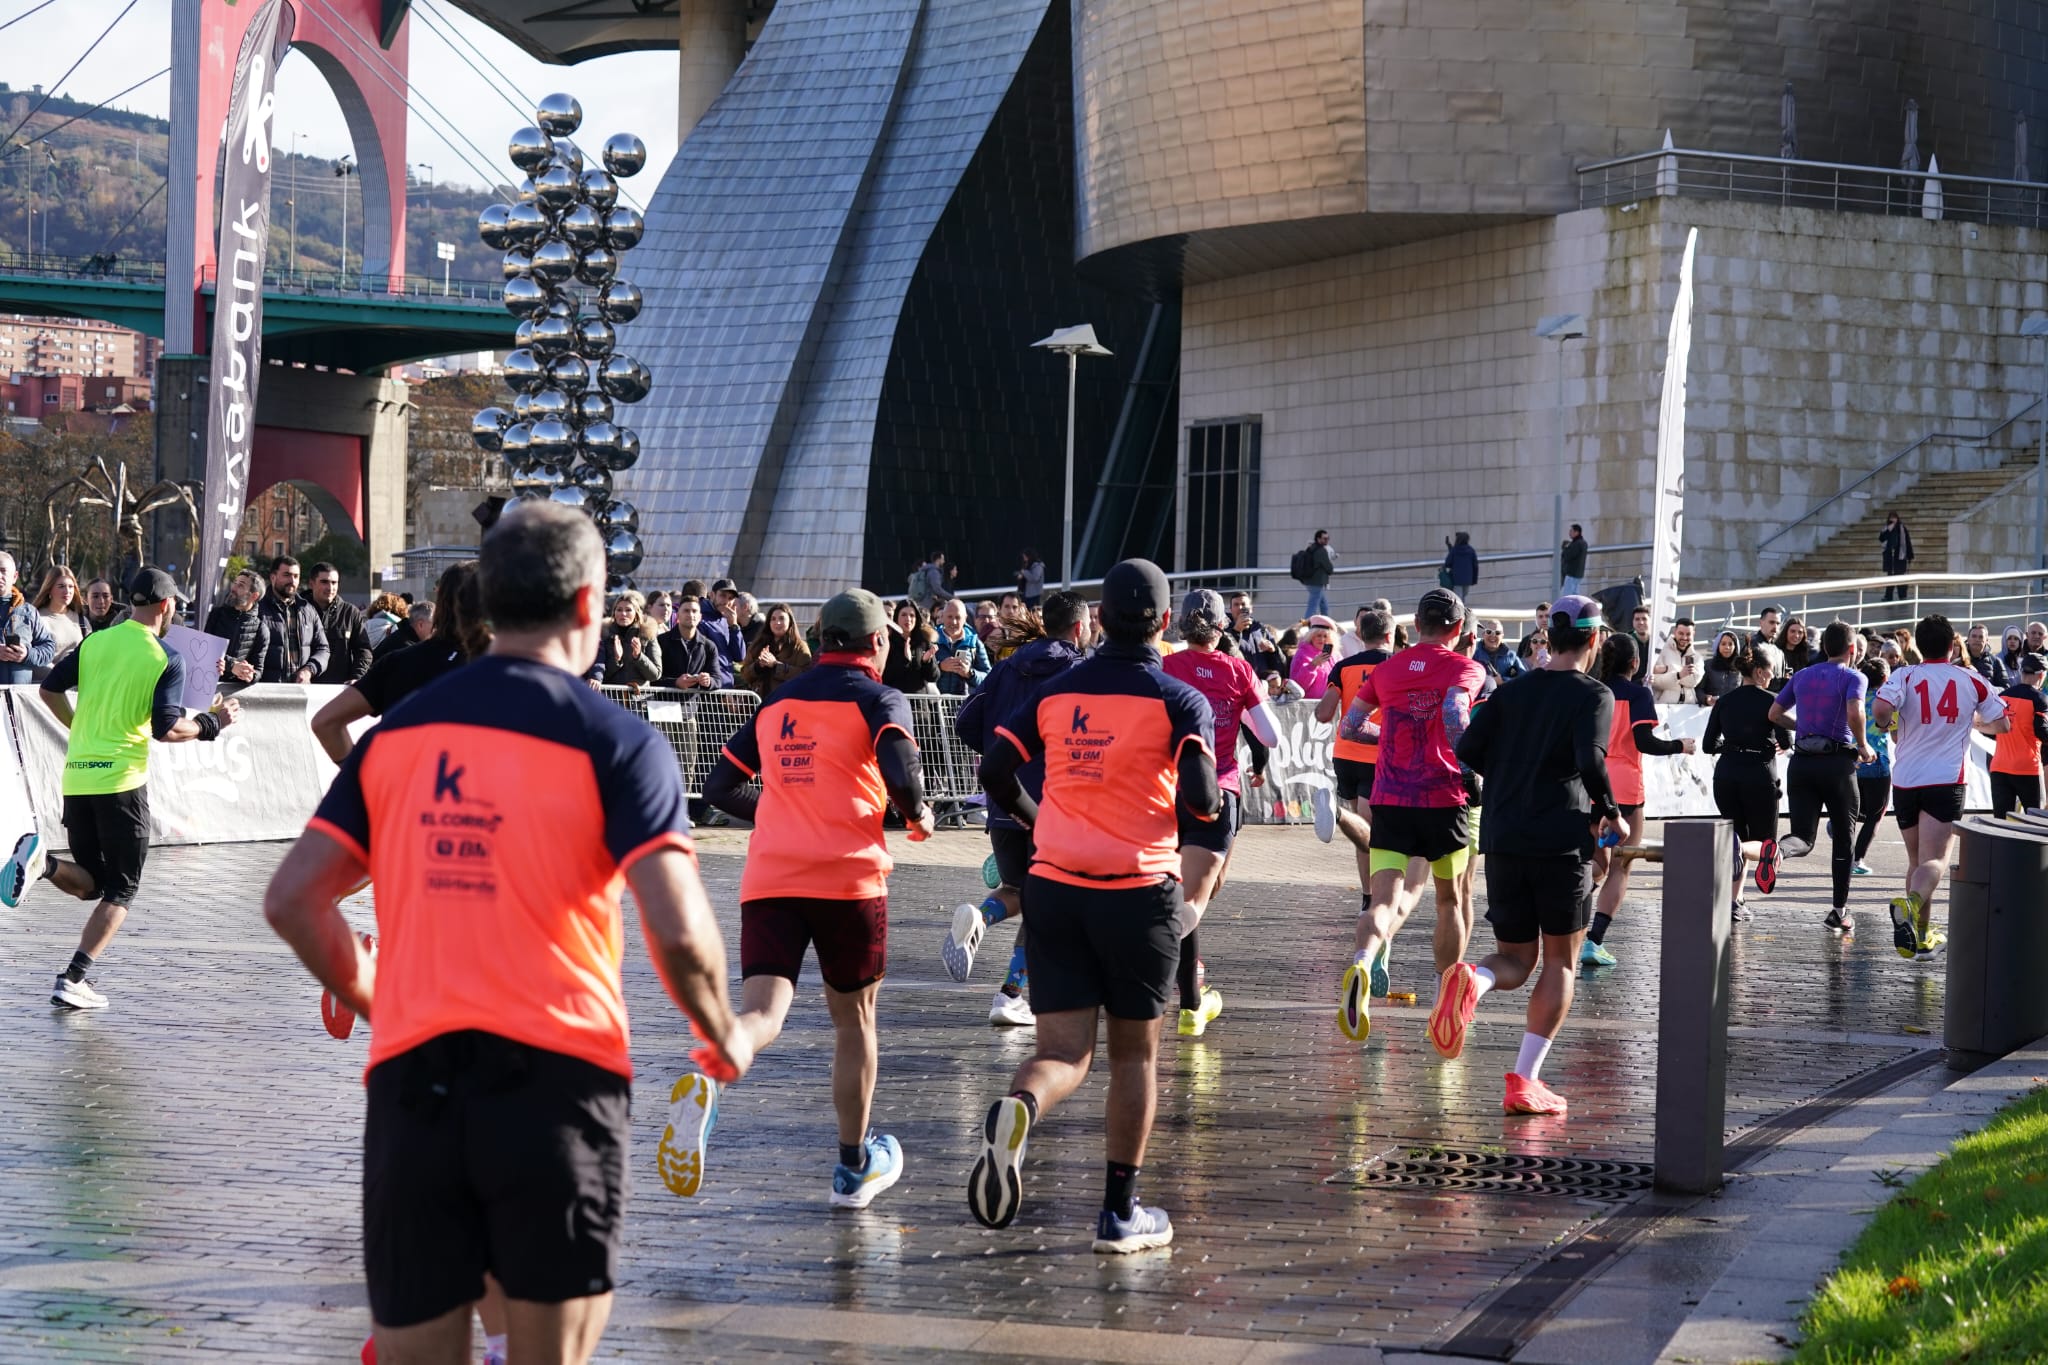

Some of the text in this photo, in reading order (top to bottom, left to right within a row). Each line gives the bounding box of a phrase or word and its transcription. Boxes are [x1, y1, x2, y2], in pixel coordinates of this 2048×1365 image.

[209, 198, 260, 612] txabank
[1408, 659, 1426, 672] GON
[1196, 666, 1213, 679] SUN
[1914, 678, 1959, 724] 14
[793, 757, 810, 767] BM
[1083, 751, 1100, 761] BM
[66, 761, 115, 769] INTERSPORT
